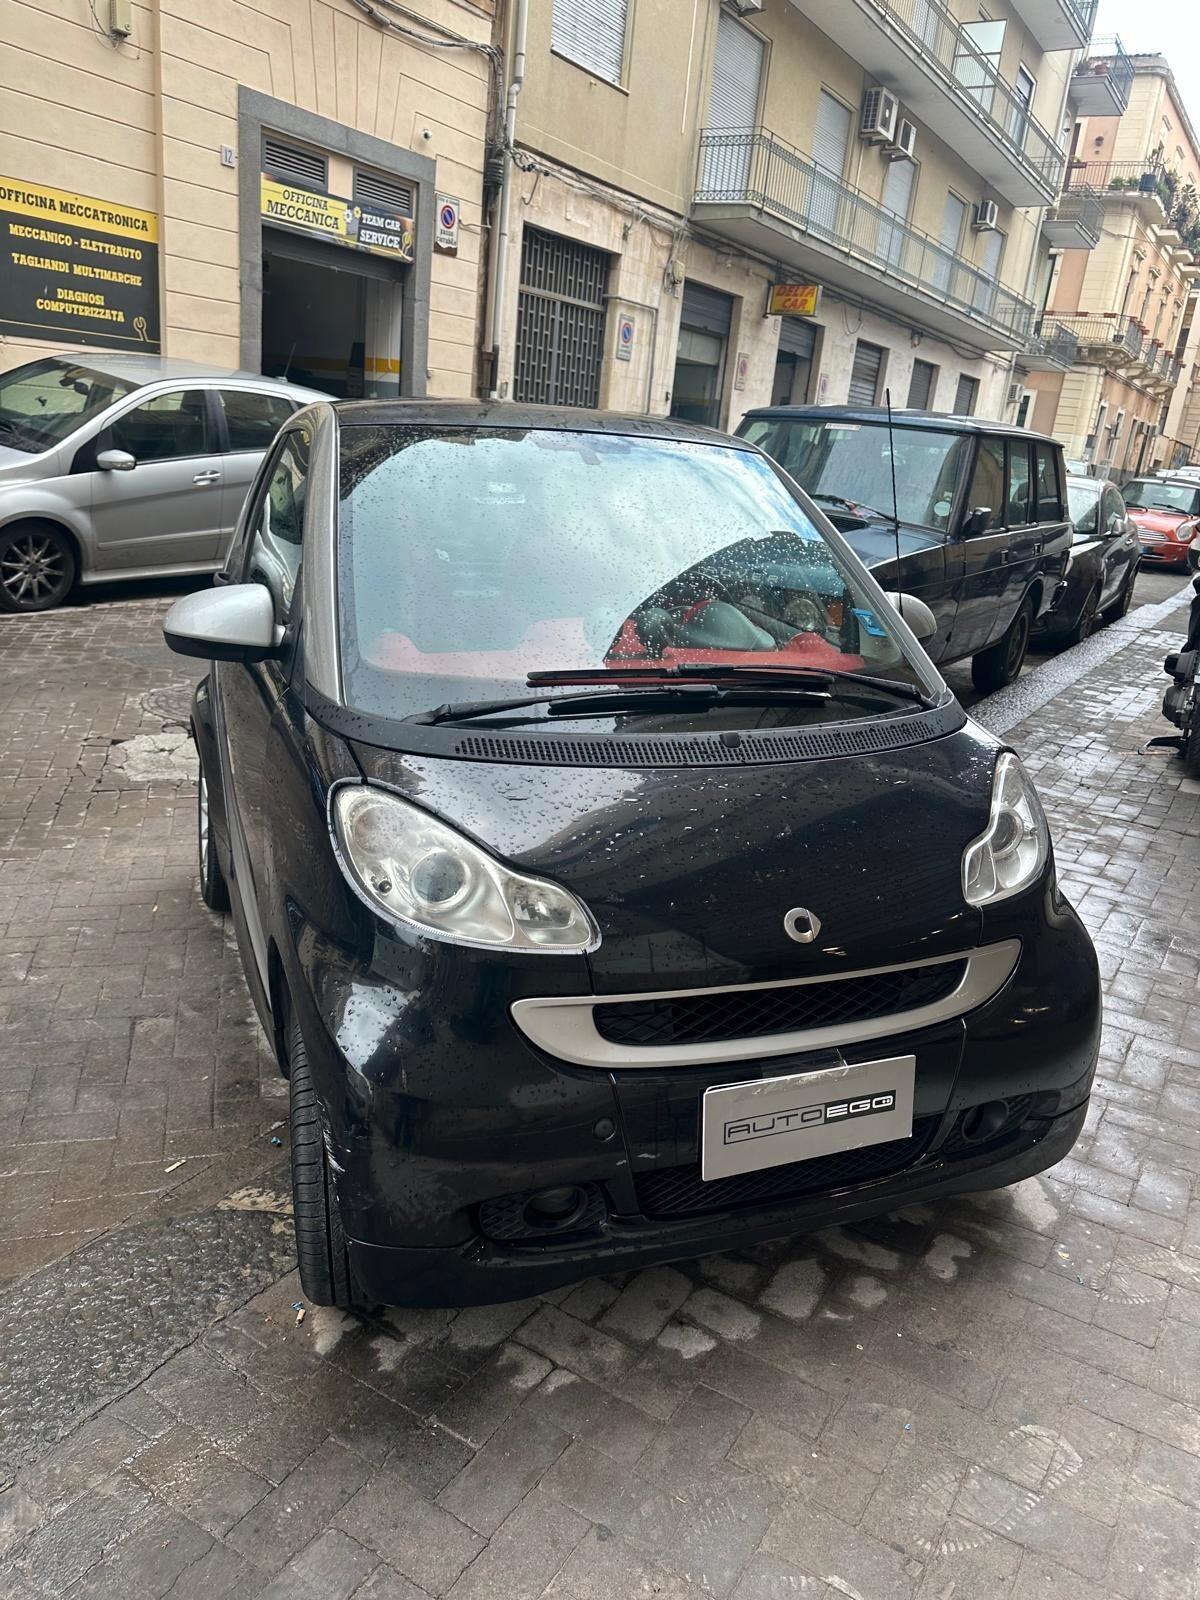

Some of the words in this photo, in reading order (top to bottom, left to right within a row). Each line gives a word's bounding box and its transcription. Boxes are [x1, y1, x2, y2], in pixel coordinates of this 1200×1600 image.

[224, 149, 233, 164] 12
[0, 187, 57, 211] OFFICINA
[59, 201, 149, 232] MECCATRONICA
[282, 189, 329, 211] OFFICINA
[266, 199, 340, 230] MECCANICA
[361, 213, 385, 228] TEAM
[384, 220, 401, 232] CAR
[9, 223, 73, 247] MECCANICO
[80, 238, 143, 261] ELETTRAUTO
[359, 229, 401, 249] SERVICE
[11, 252, 70, 274] TAGLIANDI
[73, 264, 143, 287] MULTIMARCHE
[56, 287, 105, 306] DIAGNOSI
[775, 285, 816, 298] DELTA
[36, 298, 125, 323] COMPUTERIZZATA
[782, 297, 809, 310] CAR
